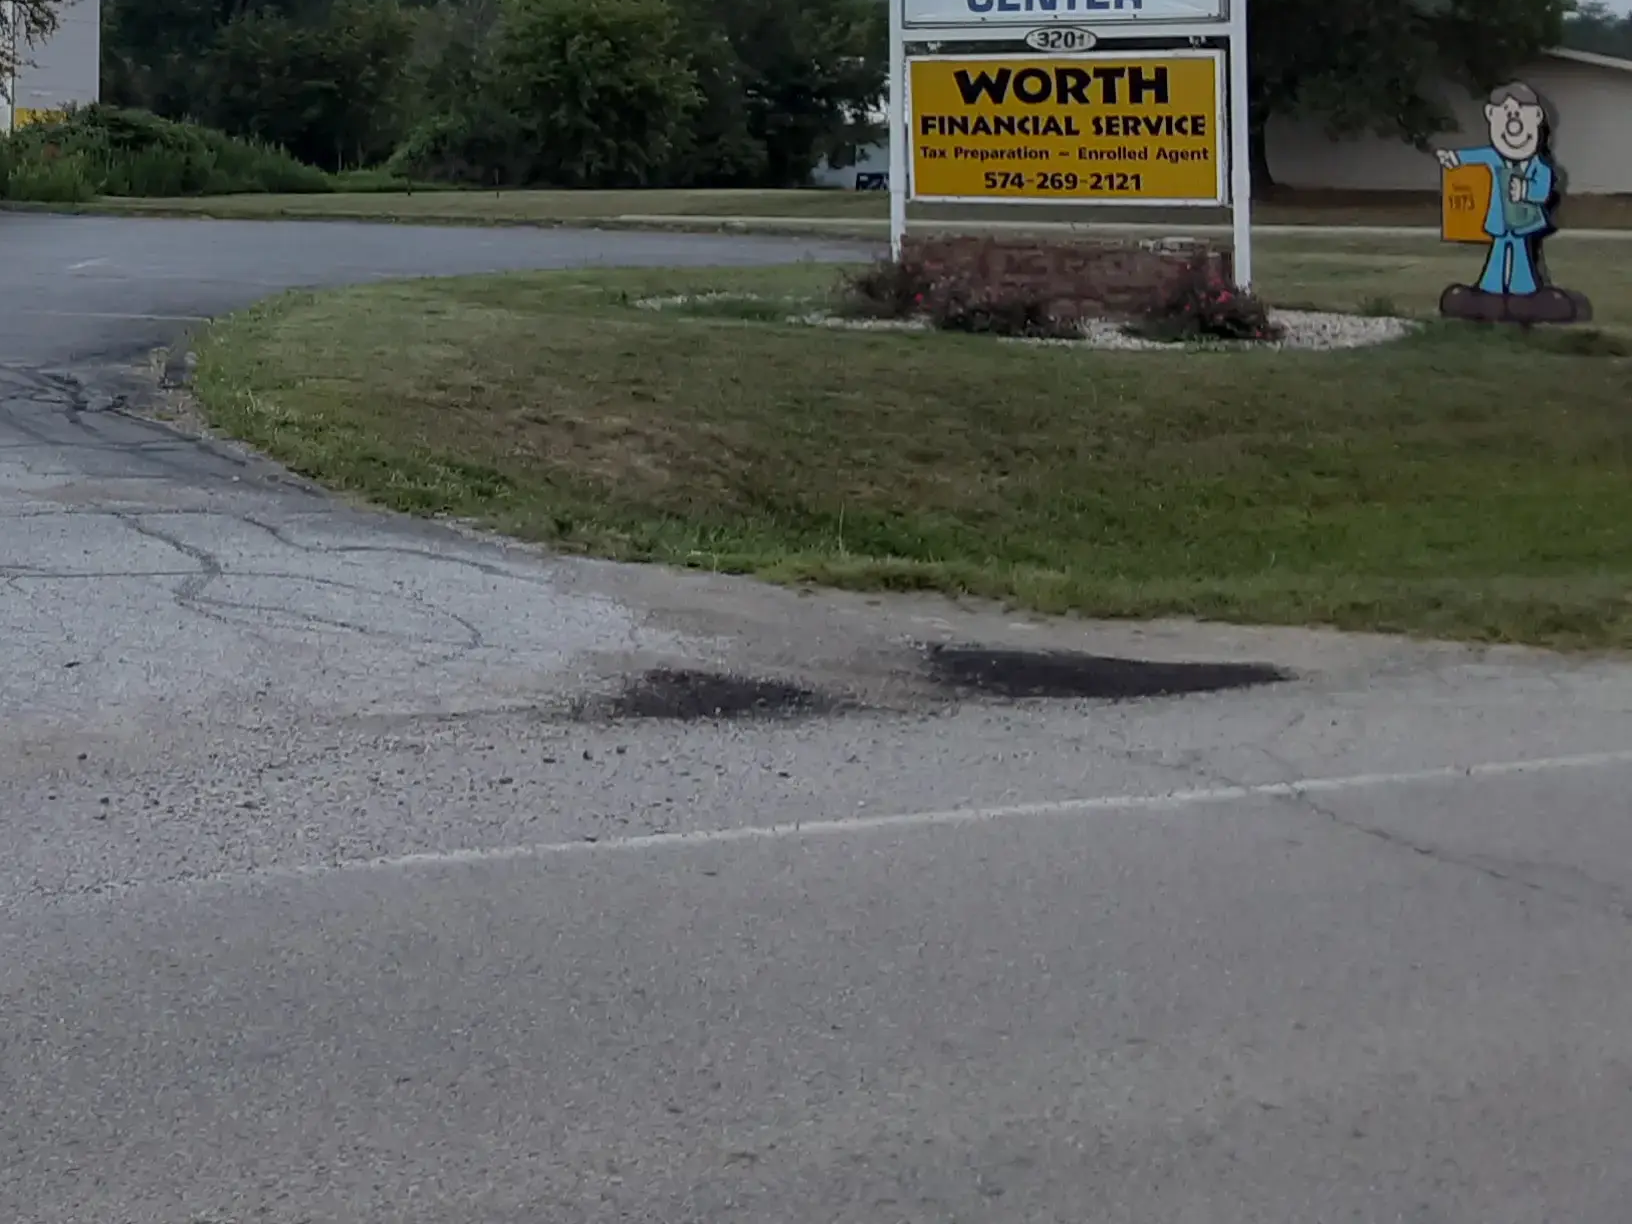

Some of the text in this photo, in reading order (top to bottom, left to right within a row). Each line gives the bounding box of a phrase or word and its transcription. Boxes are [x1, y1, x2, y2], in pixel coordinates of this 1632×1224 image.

[1037, 30, 1085, 49] 3201
[953, 65, 1169, 105] WORTH
[920, 114, 1206, 136] FINANCIAL SERVICE
[920, 146, 947, 159] Tax
[954, 146, 1050, 161] Preparation
[1078, 146, 1148, 161] Enrolled
[1155, 146, 1209, 161] Agent
[984, 171, 1142, 190] 574-269-2121
